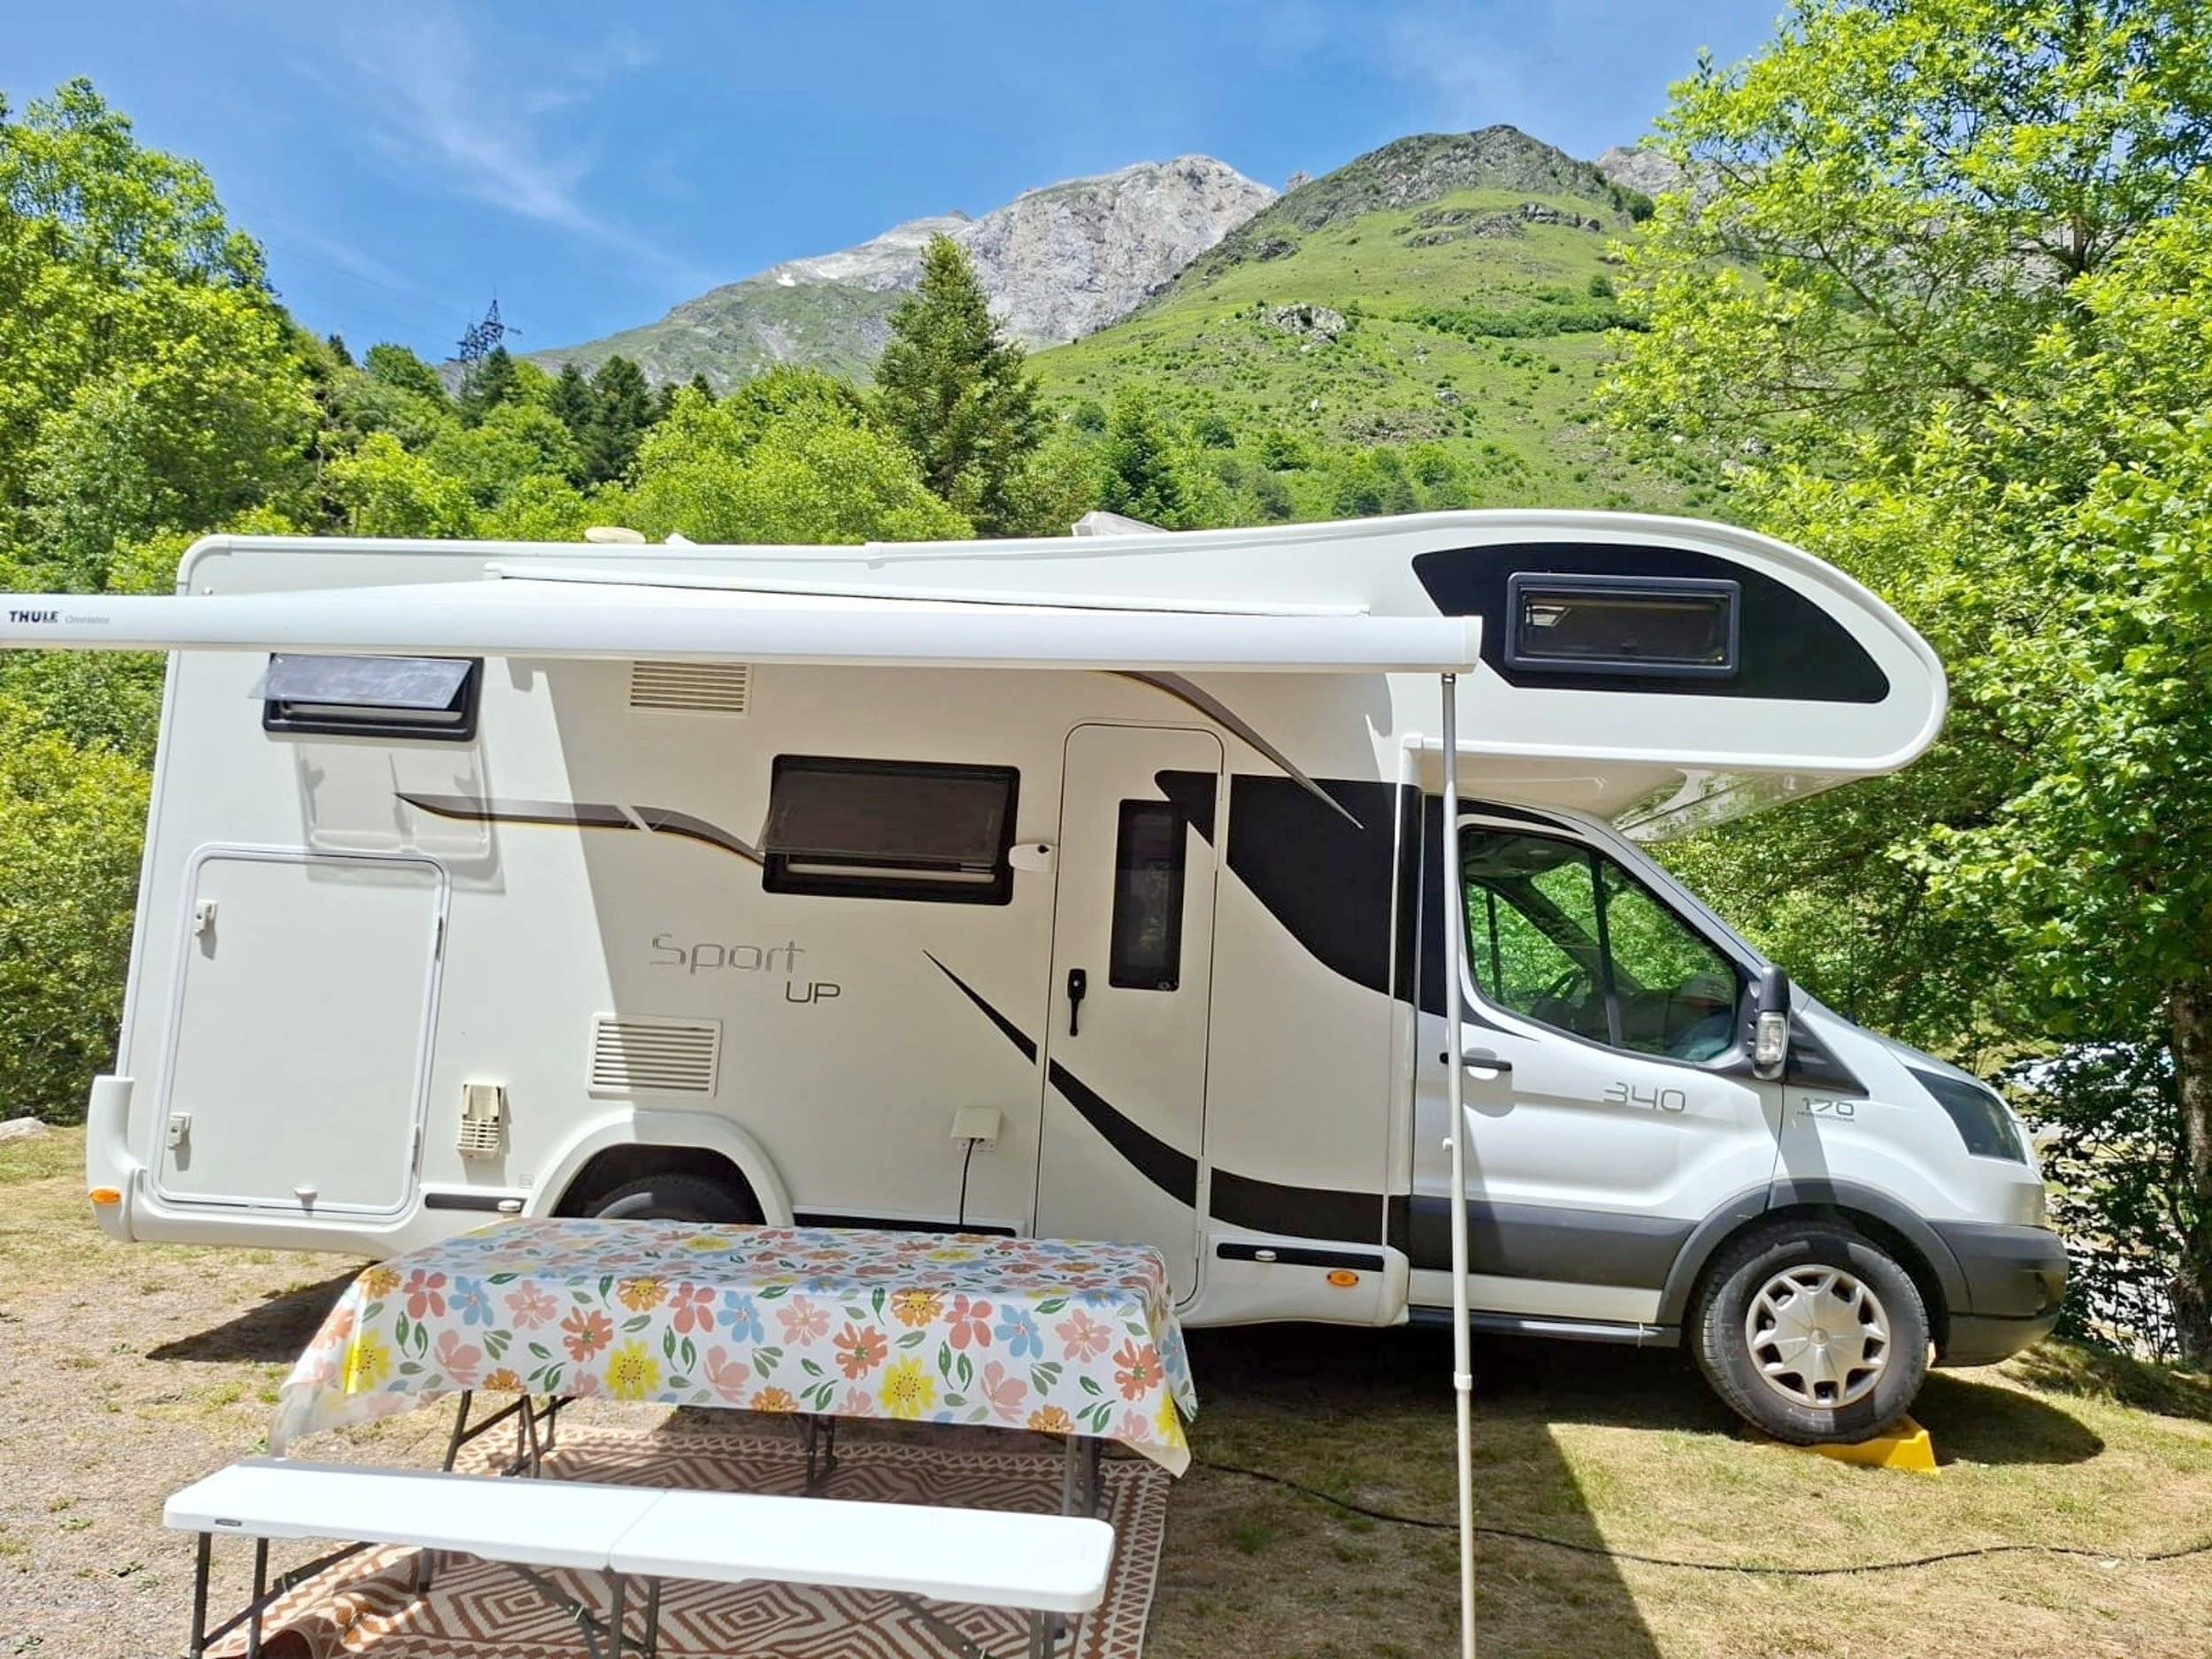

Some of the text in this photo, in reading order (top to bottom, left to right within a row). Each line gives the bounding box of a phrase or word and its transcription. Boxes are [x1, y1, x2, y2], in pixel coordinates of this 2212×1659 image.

[9, 611, 58, 623] THULE
[650, 933, 805, 974] Sport
[786, 980, 841, 1003] UP
[1603, 1081, 1686, 1113] 340
[1802, 1097, 1855, 1116] 170
